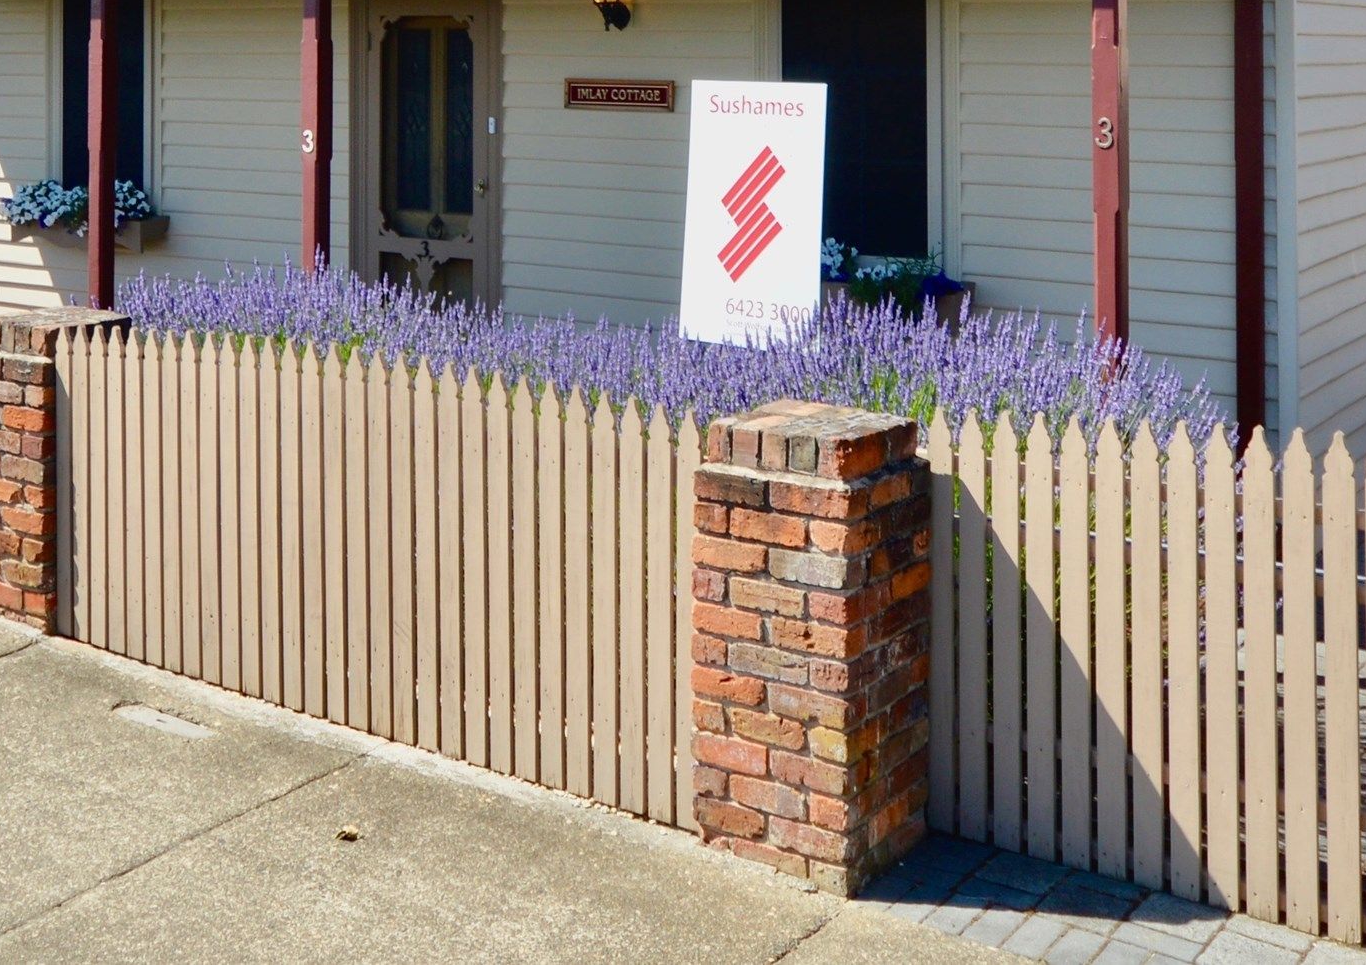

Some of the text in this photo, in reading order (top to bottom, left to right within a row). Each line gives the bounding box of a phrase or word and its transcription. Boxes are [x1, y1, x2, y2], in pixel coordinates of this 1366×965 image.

[577, 88, 661, 102] IMLAY COTTAGE
[709, 94, 804, 117] Sushames
[301, 129, 315, 153] 3
[1094, 116, 1114, 149] 3
[726, 298, 811, 325] 6423 3000
